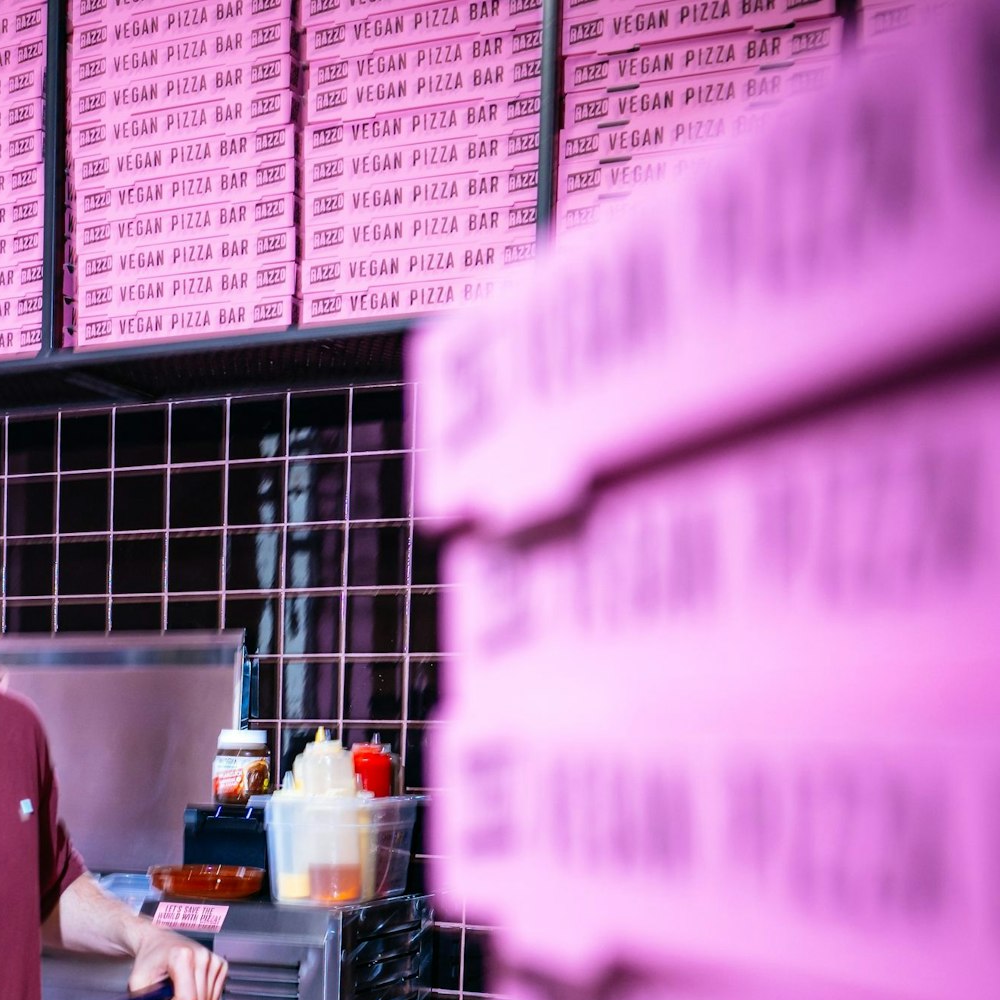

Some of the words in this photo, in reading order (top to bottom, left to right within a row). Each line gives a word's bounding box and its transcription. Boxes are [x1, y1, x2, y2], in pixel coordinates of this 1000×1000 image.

[569, 18, 603, 45] RAZZO
[613, 9, 669, 35] VEGAN
[680, 0, 730, 24] PIZZA
[79, 57, 106, 81] RAZZO
[114, 49, 158, 72] VEGAN
[167, 36, 207, 62] PIZZA
[216, 33, 242, 53] BAR
[251, 23, 281, 48] RAZZO
[318, 61, 348, 85] RAZZO
[357, 52, 407, 76] VEGAN
[417, 44, 462, 66] PIZZA
[473, 38, 503, 58] BAR
[574, 61, 608, 85] RAZZO
[618, 53, 674, 77] VEGAN
[686, 43, 735, 67] PIZZA
[747, 37, 781, 58] BAR
[316, 87, 347, 111] RAZZO
[357, 80, 407, 103] VEGAN
[417, 73, 463, 94] PIZZA
[473, 66, 504, 86] BAR
[514, 59, 541, 82] RAZZ
[574, 98, 609, 123] RAZZO
[619, 91, 674, 115] VEGAN
[685, 82, 735, 105] PIZZA
[747, 74, 781, 96] BAR
[313, 125, 343, 148] RAZZO
[352, 118, 401, 140] VEGAN
[412, 107, 457, 132] PIZZA
[467, 104, 498, 124] BAR
[565, 134, 599, 159] RAZZO
[608, 127, 664, 150] VEGAN
[82, 157, 109, 179] RAZZO
[117, 150, 161, 172] VEGAN
[171, 140, 211, 163] PIZZA
[220, 137, 247, 156] BAR
[255, 129, 285, 152] RAZZO
[313, 158, 343, 182] RAZZO
[352, 151, 402, 174] VEGAN
[413, 144, 458, 166] PIZZA
[468, 140, 498, 159] BAR
[567, 168, 601, 193] RAZZO
[84, 224, 111, 245] RAZZO
[118, 217, 162, 238] VEGAN
[172, 210, 211, 230] PIZZA
[220, 206, 247, 224] BAR
[255, 199, 285, 221] RAZZO
[313, 226, 344, 249] RAZZO
[353, 221, 402, 243] VEGAN
[413, 216, 458, 236] PIZZA
[469, 212, 499, 231] BAR
[509, 206, 536, 229] RAZZ
[85, 255, 112, 276] RAZZO
[120, 250, 164, 270] VEGAN
[173, 243, 212, 264] PIZZA
[222, 240, 248, 257] BAR
[257, 233, 286, 255] RAZZO
[310, 262, 340, 284] RAZZO
[350, 257, 399, 278] VEGAN
[409, 252, 454, 272] PIZZA
[465, 248, 494, 267] BAR
[85, 286, 112, 307] RAZZO
[120, 282, 164, 302] VEGAN
[173, 275, 212, 296] PIZZA
[222, 272, 248, 291] BAR
[256, 266, 286, 288] RAZZO
[311, 296, 342, 317] RAZZO
[351, 291, 399, 311] VEGAN
[410, 286, 454, 306] PIZZA
[465, 281, 493, 300] BAR
[85, 319, 112, 340] RAZZO
[120, 313, 162, 335] VEGAN
[172, 308, 211, 329] PIZZA
[220, 306, 246, 324] BAR
[254, 301, 283, 322] RAZZO
[184, 906, 200, 914] SAVE
